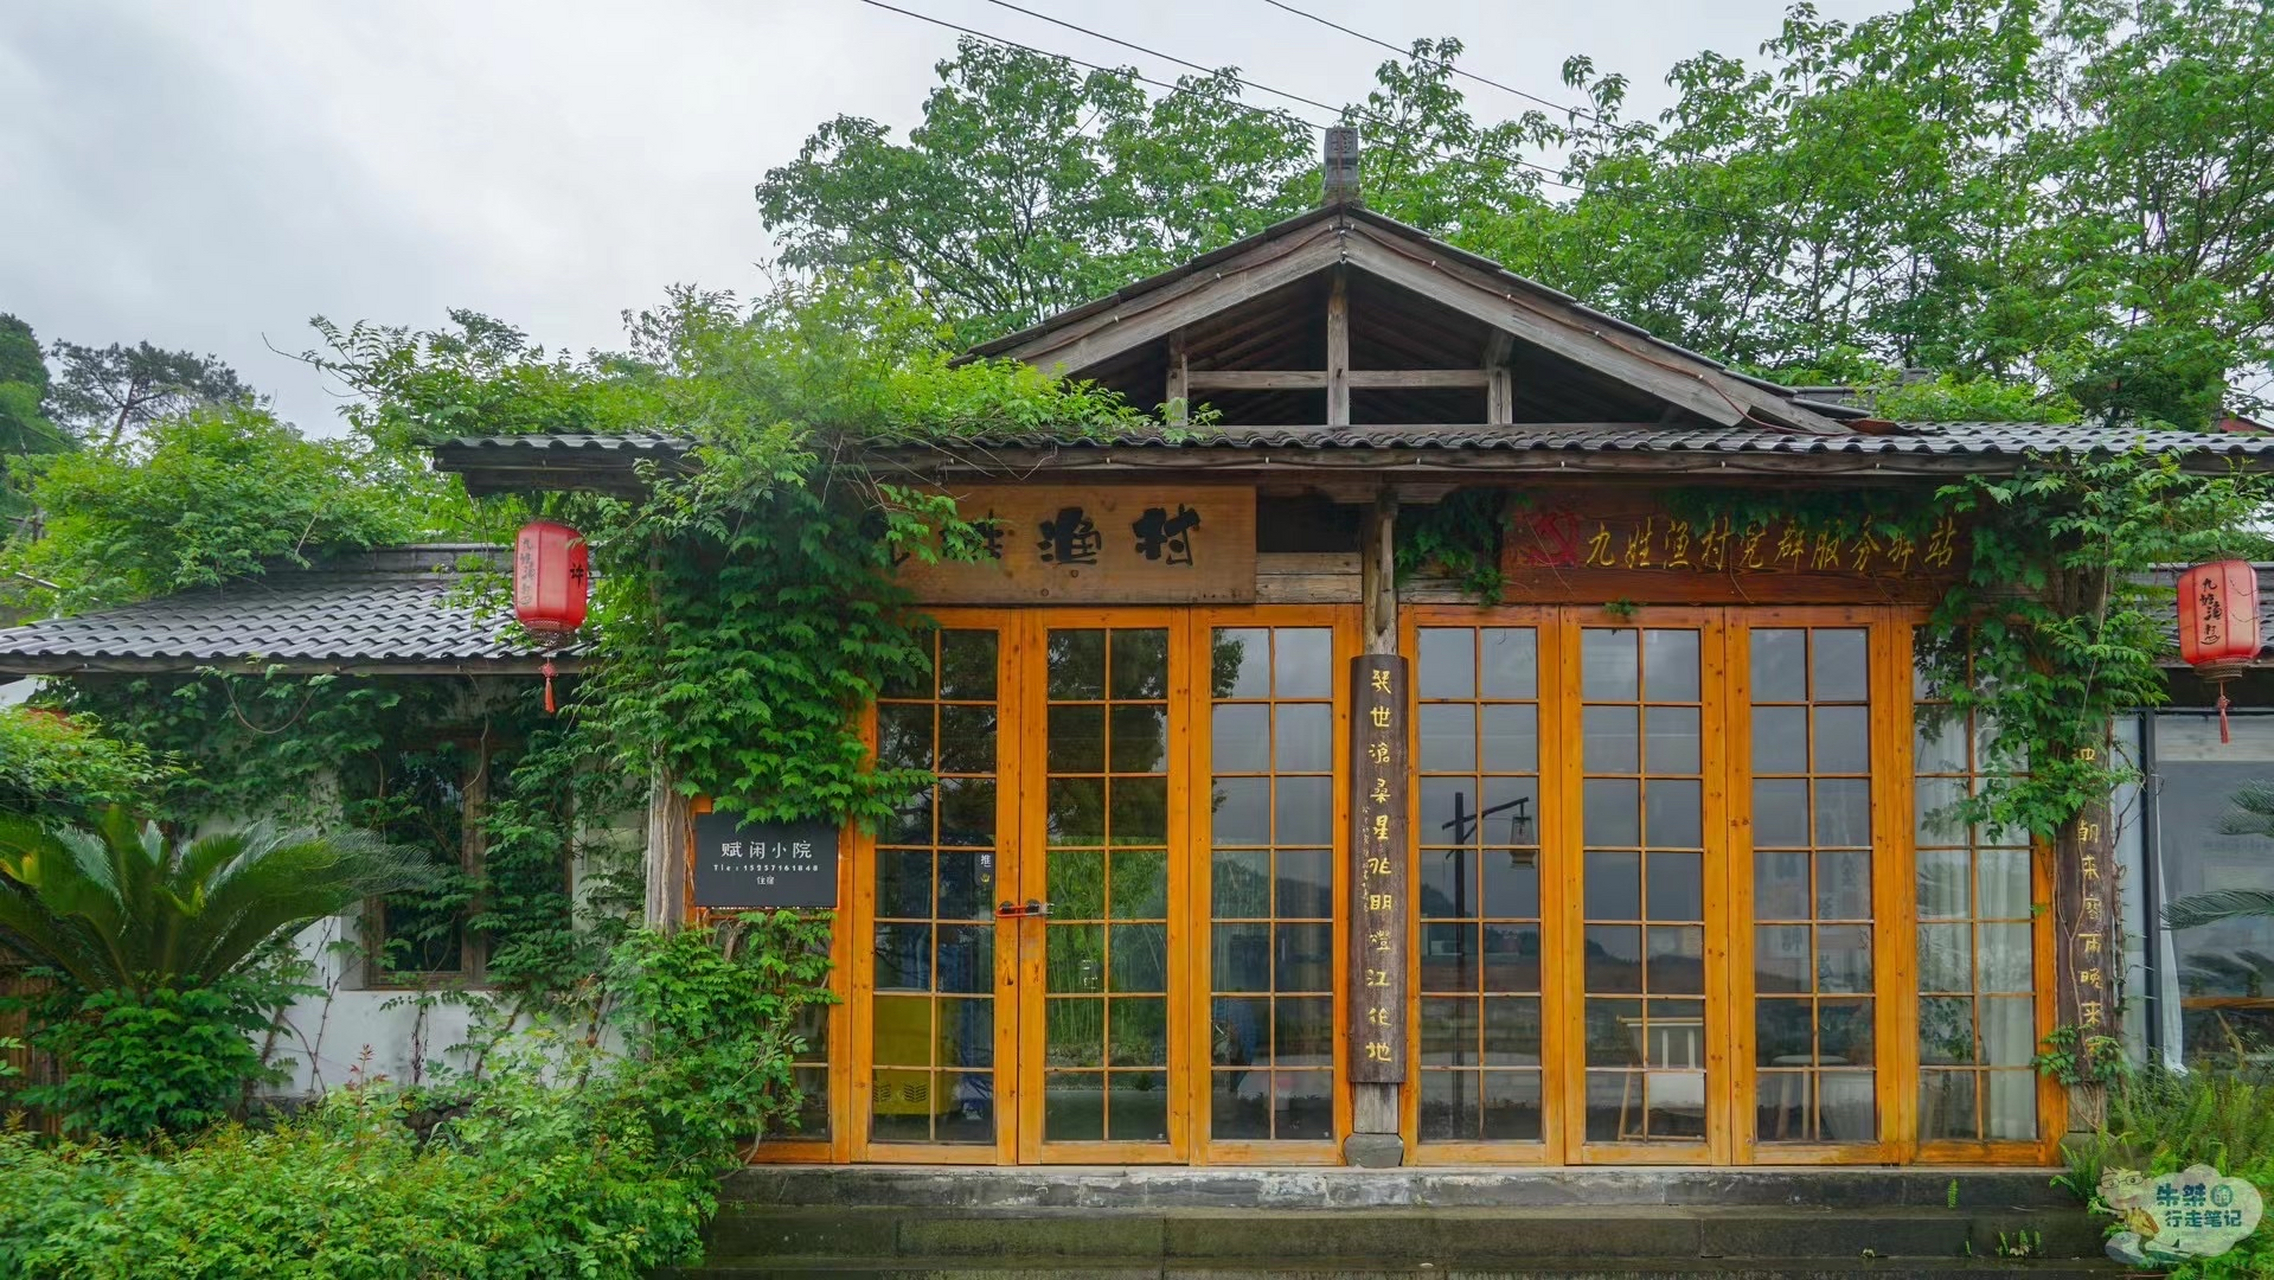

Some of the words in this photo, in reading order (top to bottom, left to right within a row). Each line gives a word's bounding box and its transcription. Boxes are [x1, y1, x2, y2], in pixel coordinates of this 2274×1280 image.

[720, 840, 813, 860] 赋闲小院
[980, 854, 992, 868] 推
[756, 875, 775, 885] 住宿
